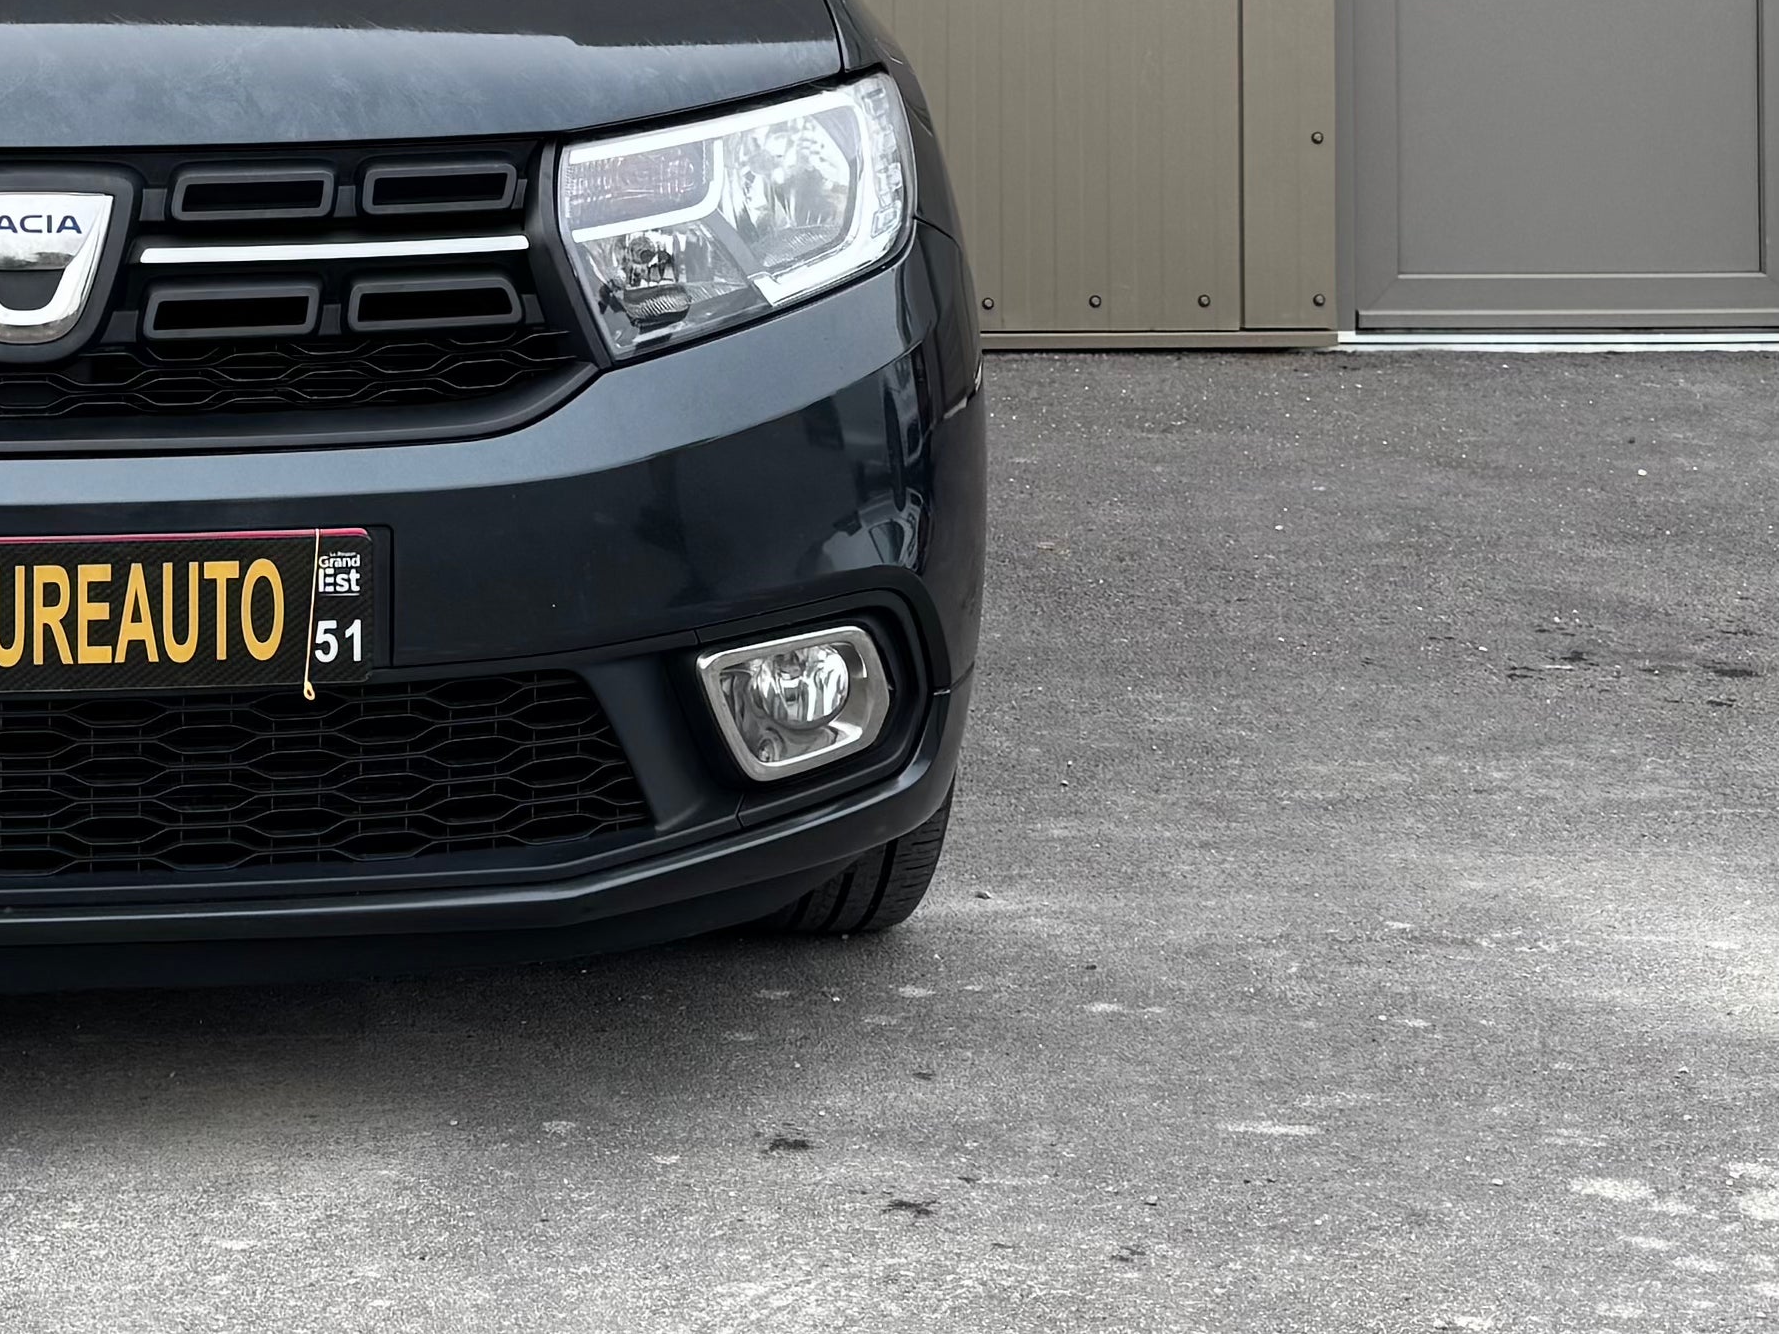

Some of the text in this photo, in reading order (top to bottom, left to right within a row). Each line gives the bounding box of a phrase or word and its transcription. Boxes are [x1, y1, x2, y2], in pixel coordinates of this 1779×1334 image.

[318, 554, 361, 568] Grand
[318, 568, 361, 592] Est
[314, 619, 362, 663] 51
